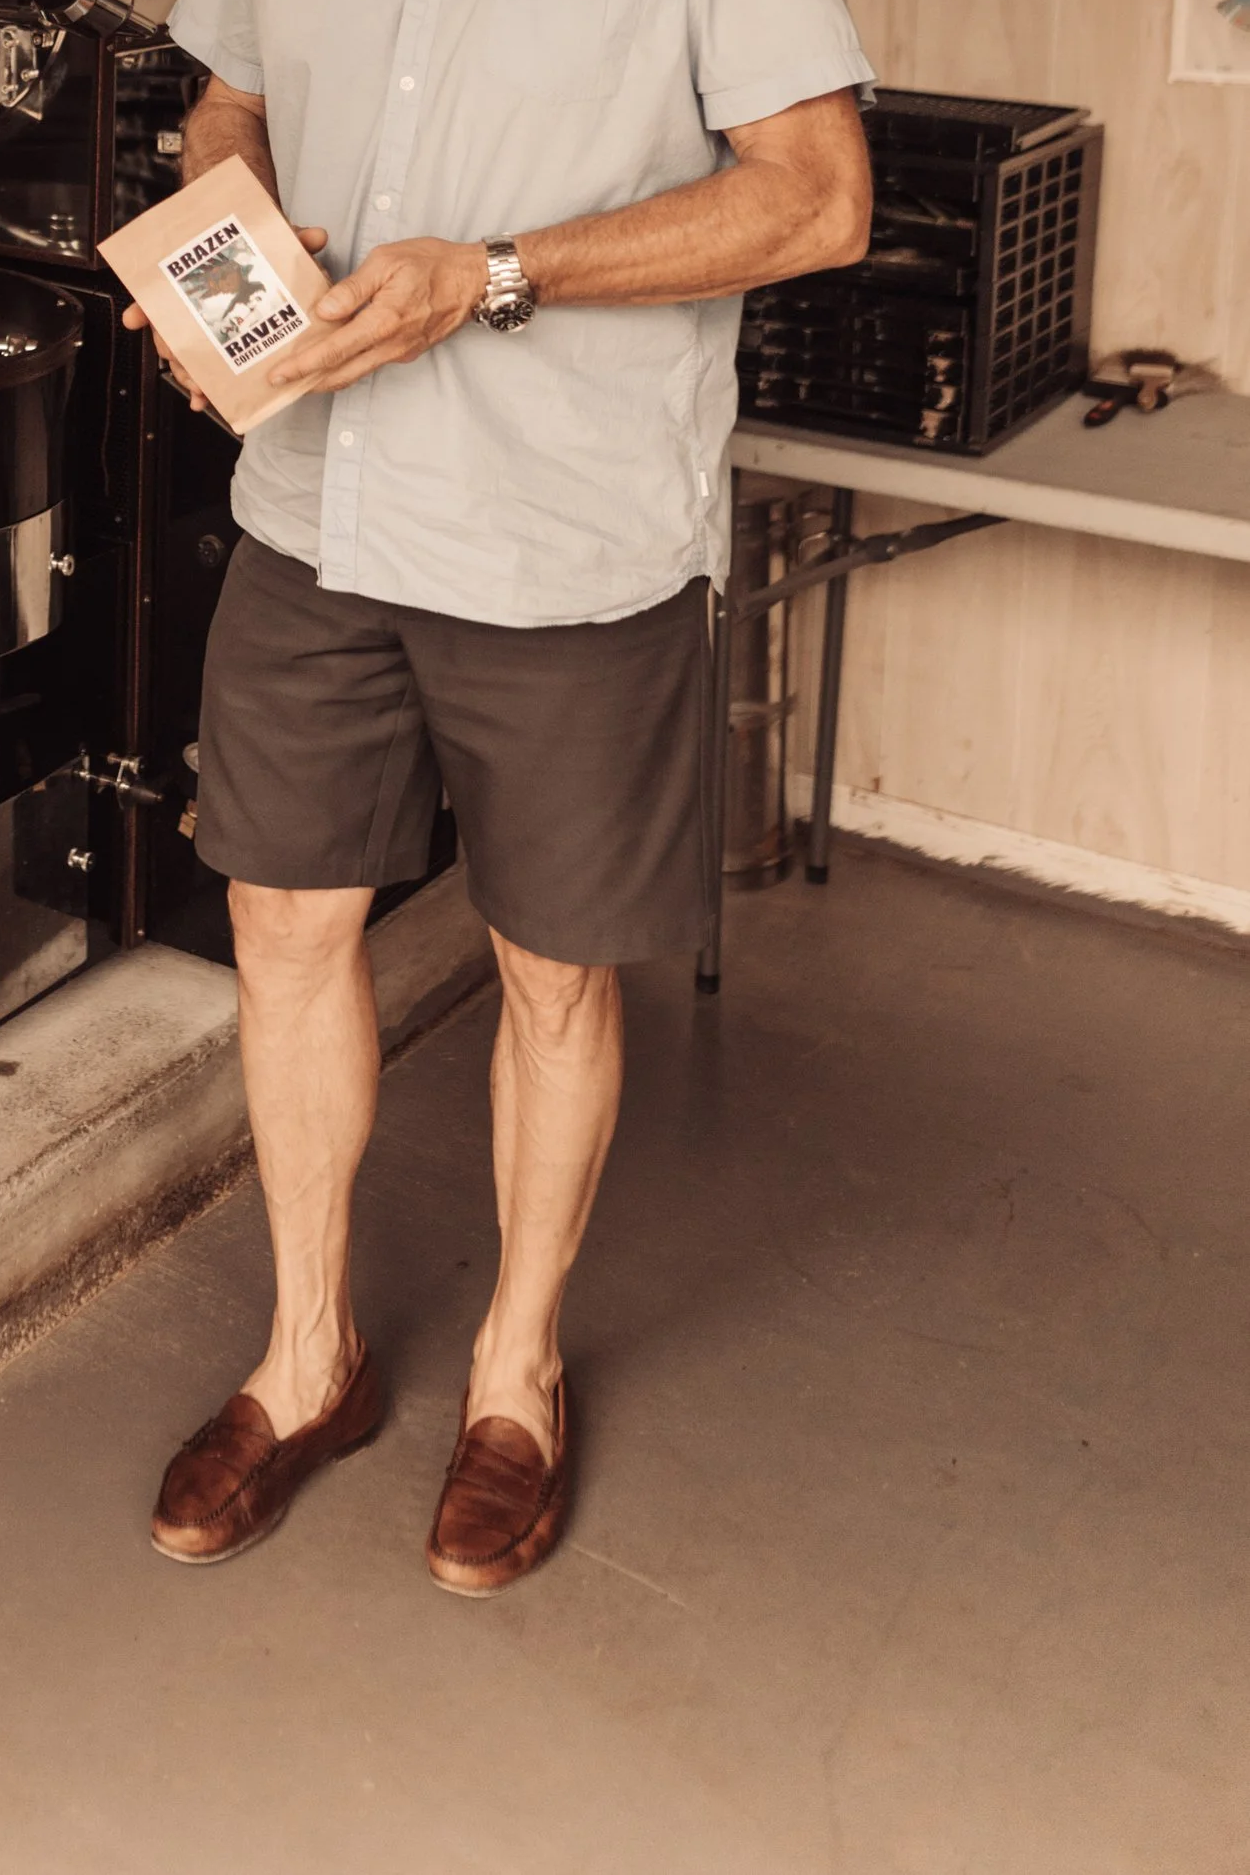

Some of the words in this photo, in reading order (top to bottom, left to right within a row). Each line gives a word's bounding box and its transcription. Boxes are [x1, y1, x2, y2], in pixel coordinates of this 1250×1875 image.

[166, 222, 240, 278] BRAZEN
[224, 303, 297, 358] RAVEN
[233, 344, 263, 367] COFFEE
[261, 317, 303, 349] ROASTERS
